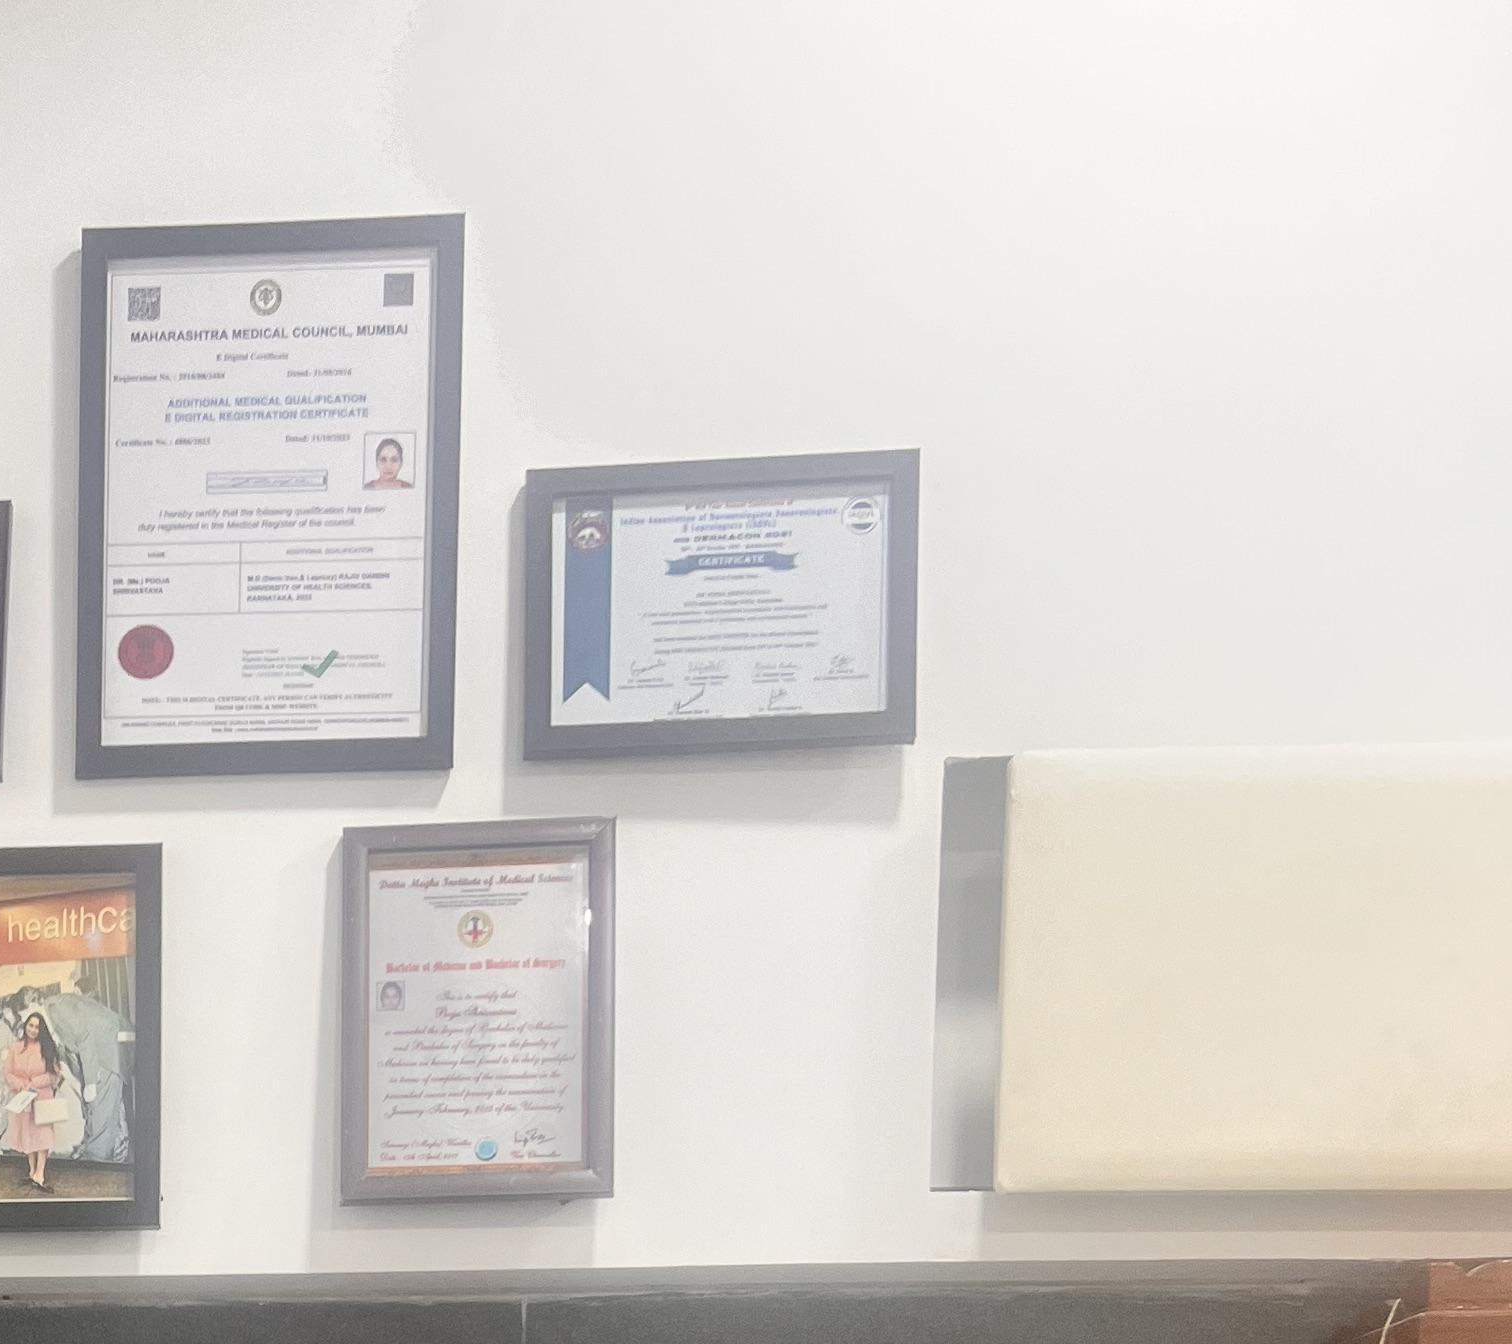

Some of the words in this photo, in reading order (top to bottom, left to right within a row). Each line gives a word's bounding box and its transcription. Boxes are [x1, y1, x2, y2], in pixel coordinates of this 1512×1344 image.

[131, 329, 228, 343] MAHARASHTRA
[232, 329, 288, 341] MEDICAL
[292, 326, 353, 339] COUNCIL,
[357, 324, 408, 337] MUMBAI
[168, 397, 231, 409] ADDITIONAL
[235, 396, 281, 407] MEDICAL
[285, 393, 367, 406] QUALIFICATION
[174, 412, 216, 422] DIGITAL
[219, 410, 296, 421] REGISTRATION
[300, 408, 369, 419] CERTIFICATE
[698, 554, 767, 567] CERTIFICATE
[495, 873, 535, 885] Medical
